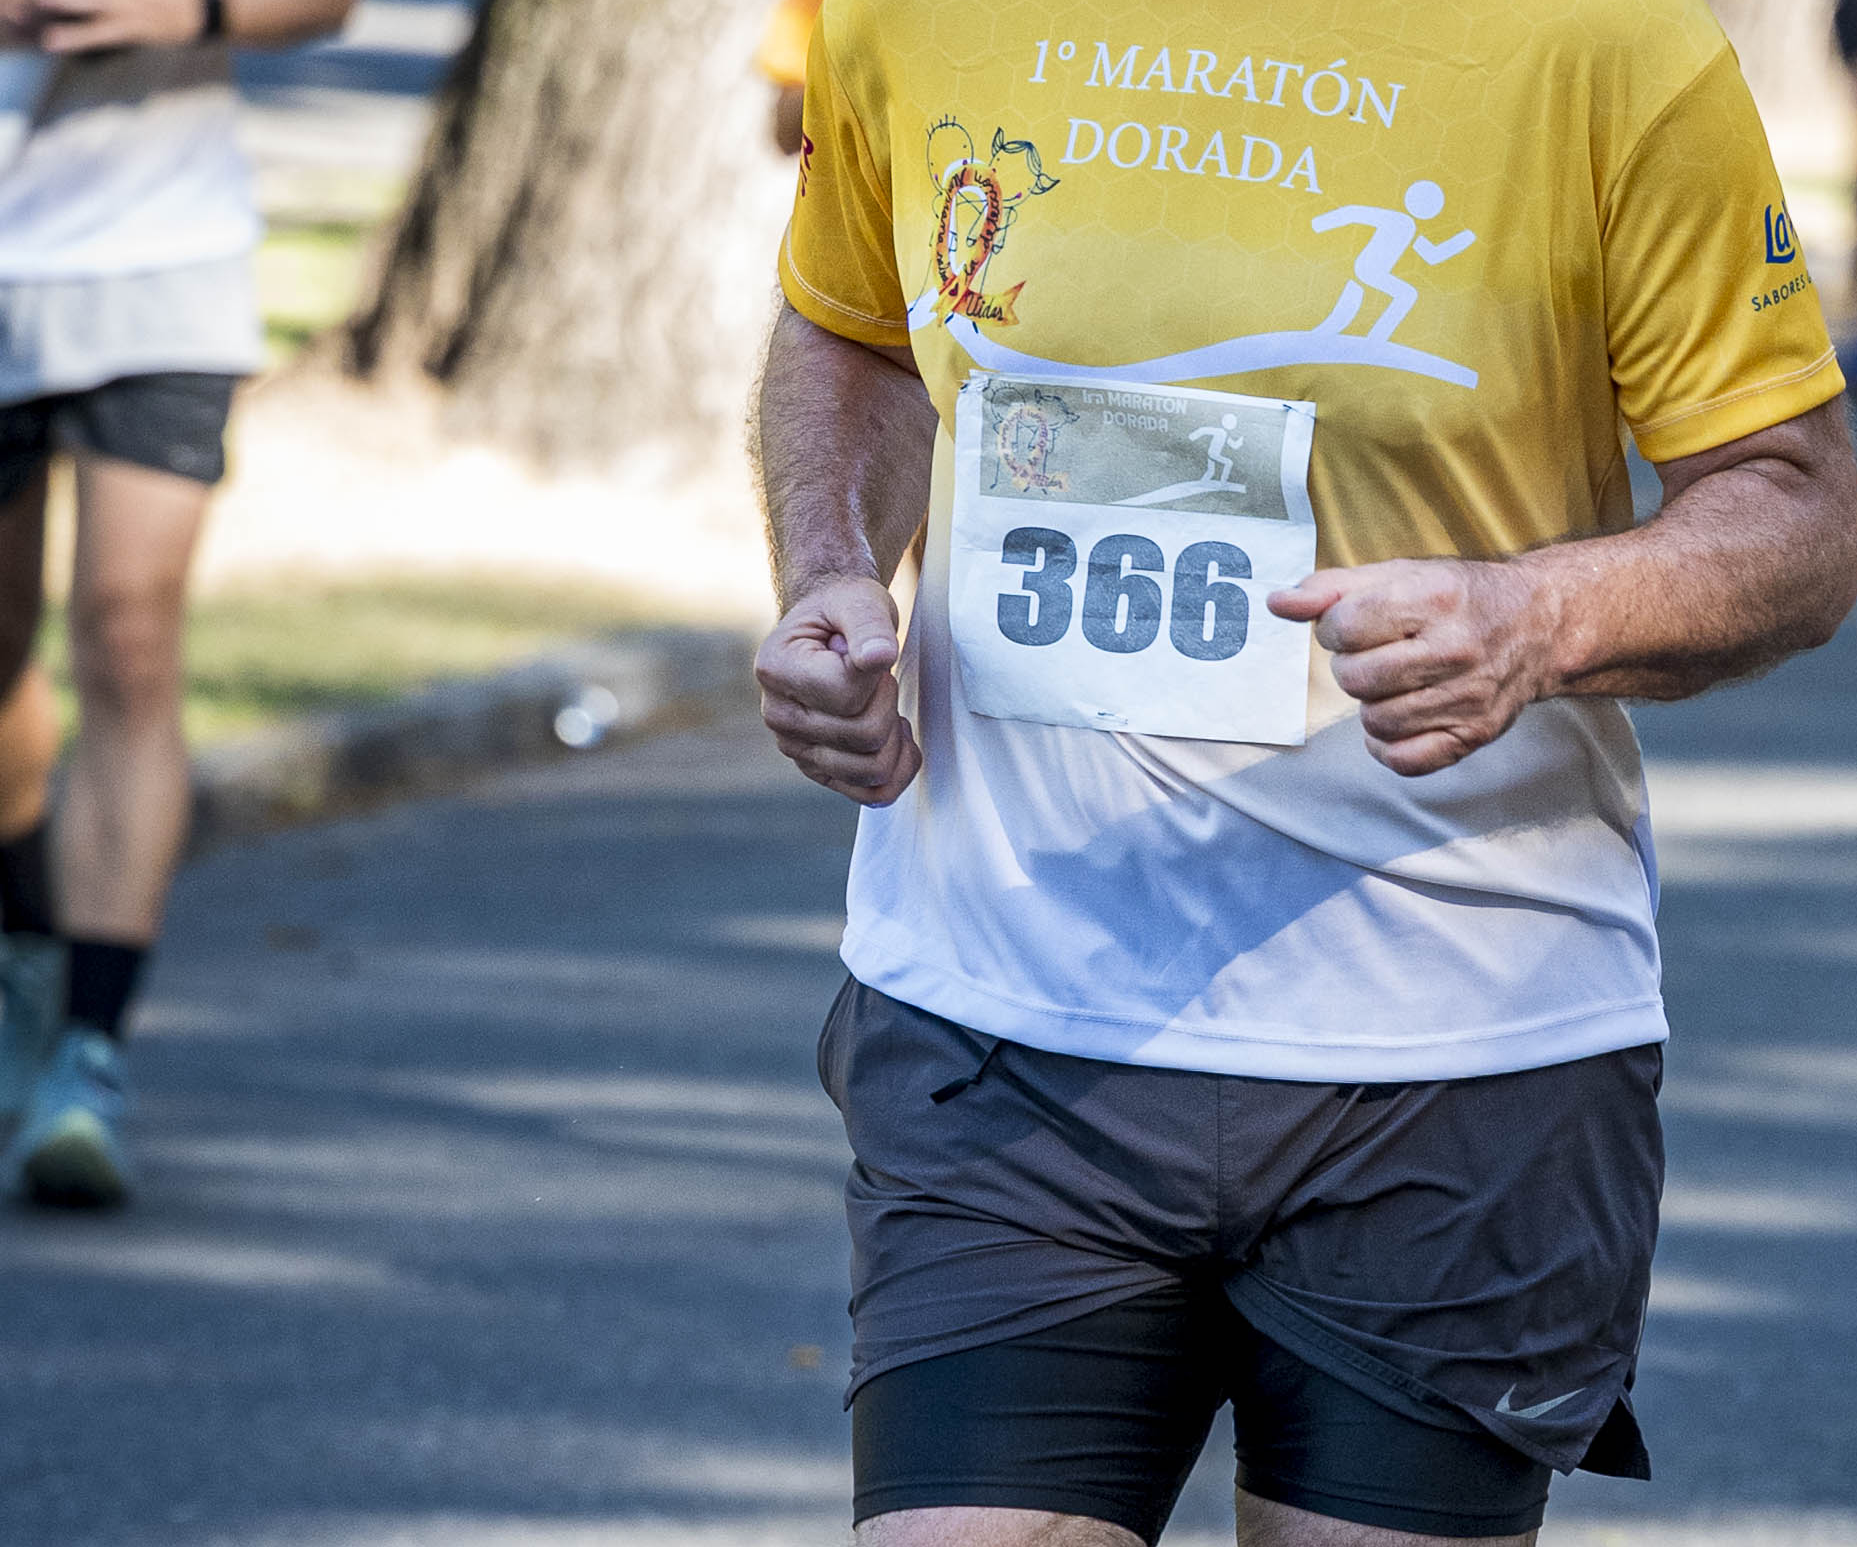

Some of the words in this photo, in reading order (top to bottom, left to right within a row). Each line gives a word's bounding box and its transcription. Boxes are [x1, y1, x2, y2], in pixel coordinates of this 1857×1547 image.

[1085, 41, 1407, 130] MARATÓN
[1059, 117, 1323, 194] DORADA
[1751, 274, 1807, 312] SABORES
[1103, 410, 1168, 433] DORADA
[997, 526, 1253, 661] 366
